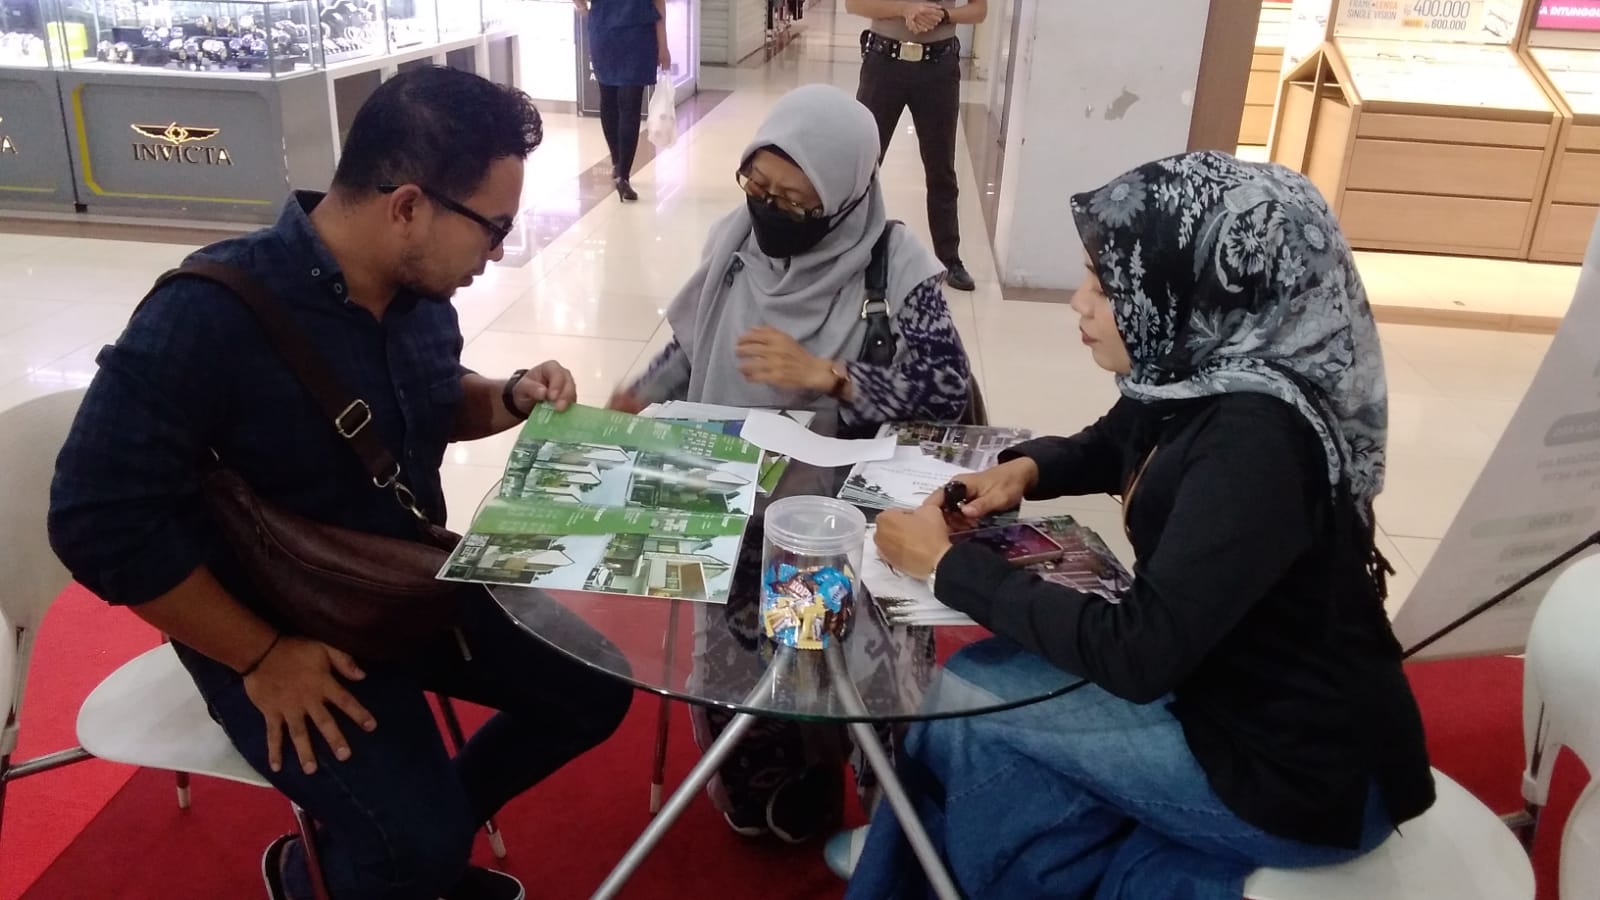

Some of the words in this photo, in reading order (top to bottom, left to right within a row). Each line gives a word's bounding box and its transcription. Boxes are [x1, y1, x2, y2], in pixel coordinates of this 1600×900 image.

[1413, 0, 1471, 18] 400.000
[1431, 19, 1467, 30] 600.000
[132, 143, 234, 166] INVICTA
